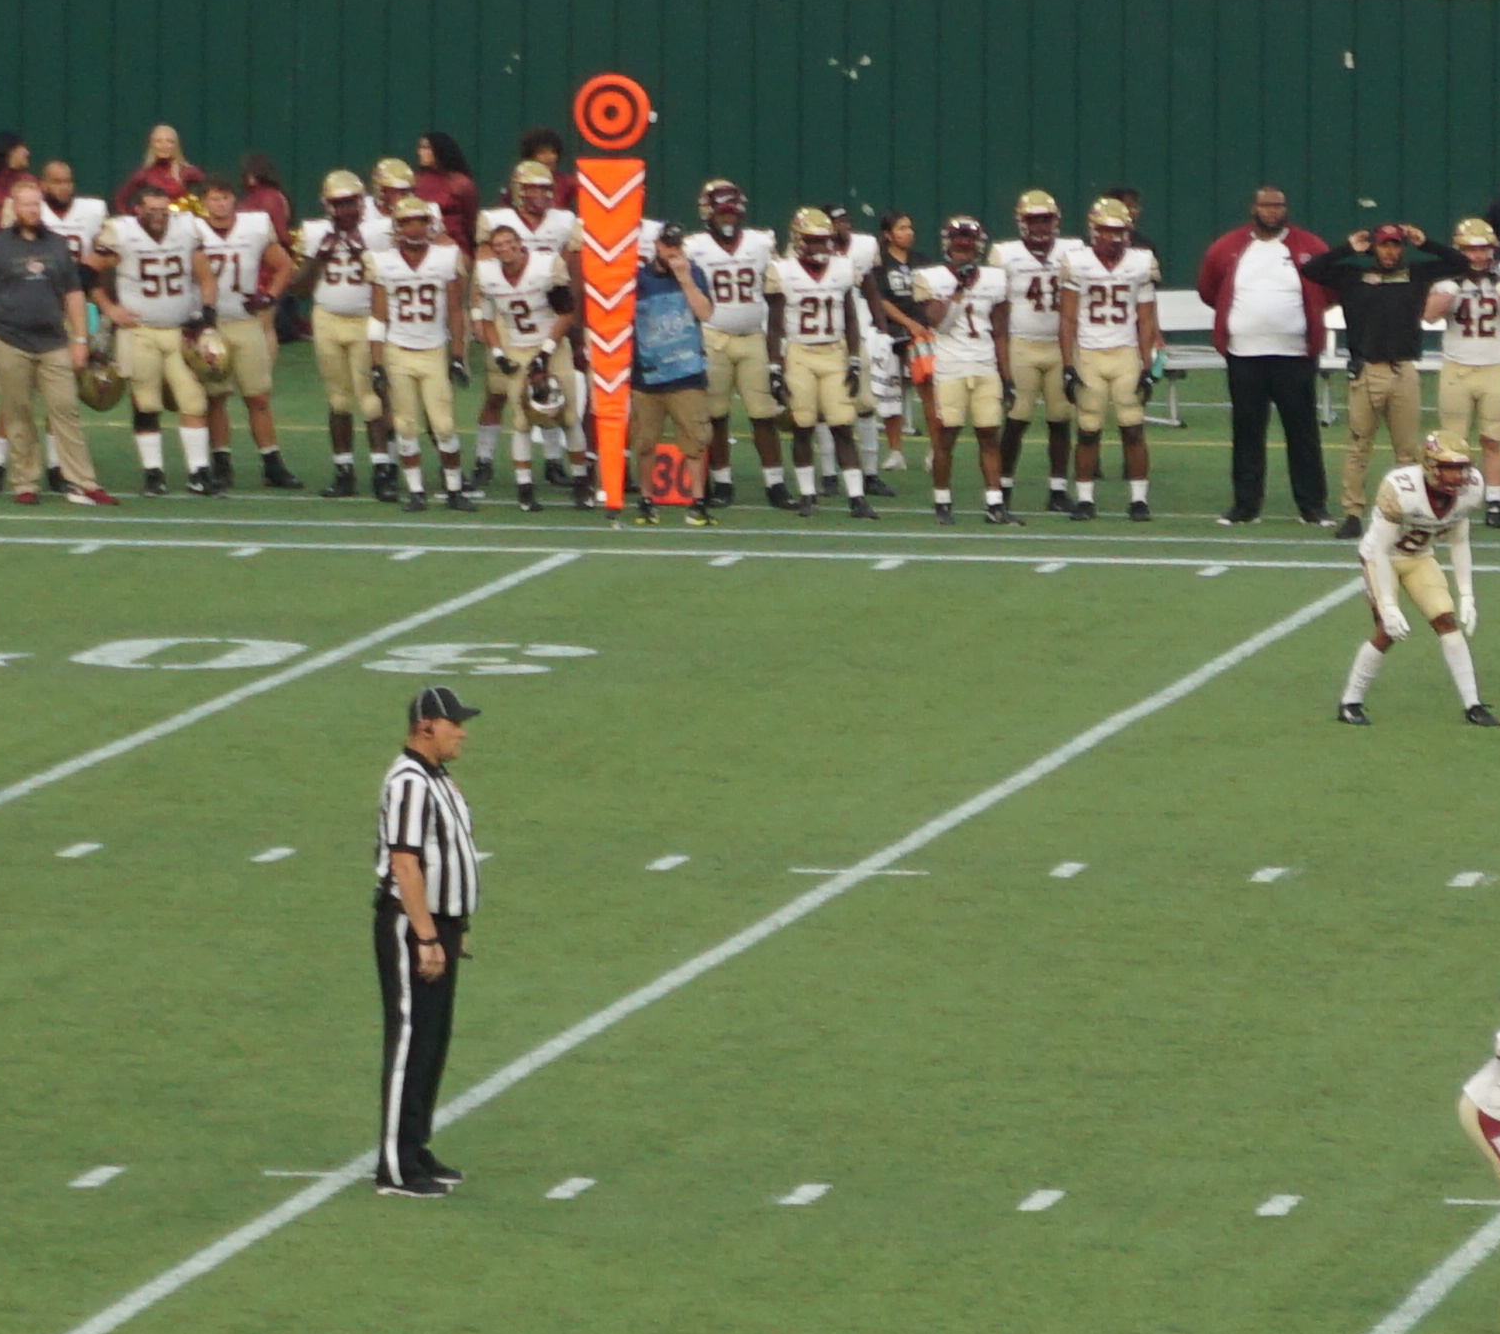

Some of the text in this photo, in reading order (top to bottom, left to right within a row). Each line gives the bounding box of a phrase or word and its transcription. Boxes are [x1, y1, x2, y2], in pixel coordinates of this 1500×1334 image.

[139, 255, 184, 298] 52
[713, 268, 756, 304] 62
[1026, 275, 1060, 313] 41
[395, 283, 436, 323] 29
[509, 299, 537, 336] 2
[799, 296, 837, 336] 21
[964, 301, 980, 338] 1
[1087, 283, 1129, 325] 25
[1455, 295, 1498, 339] 42
